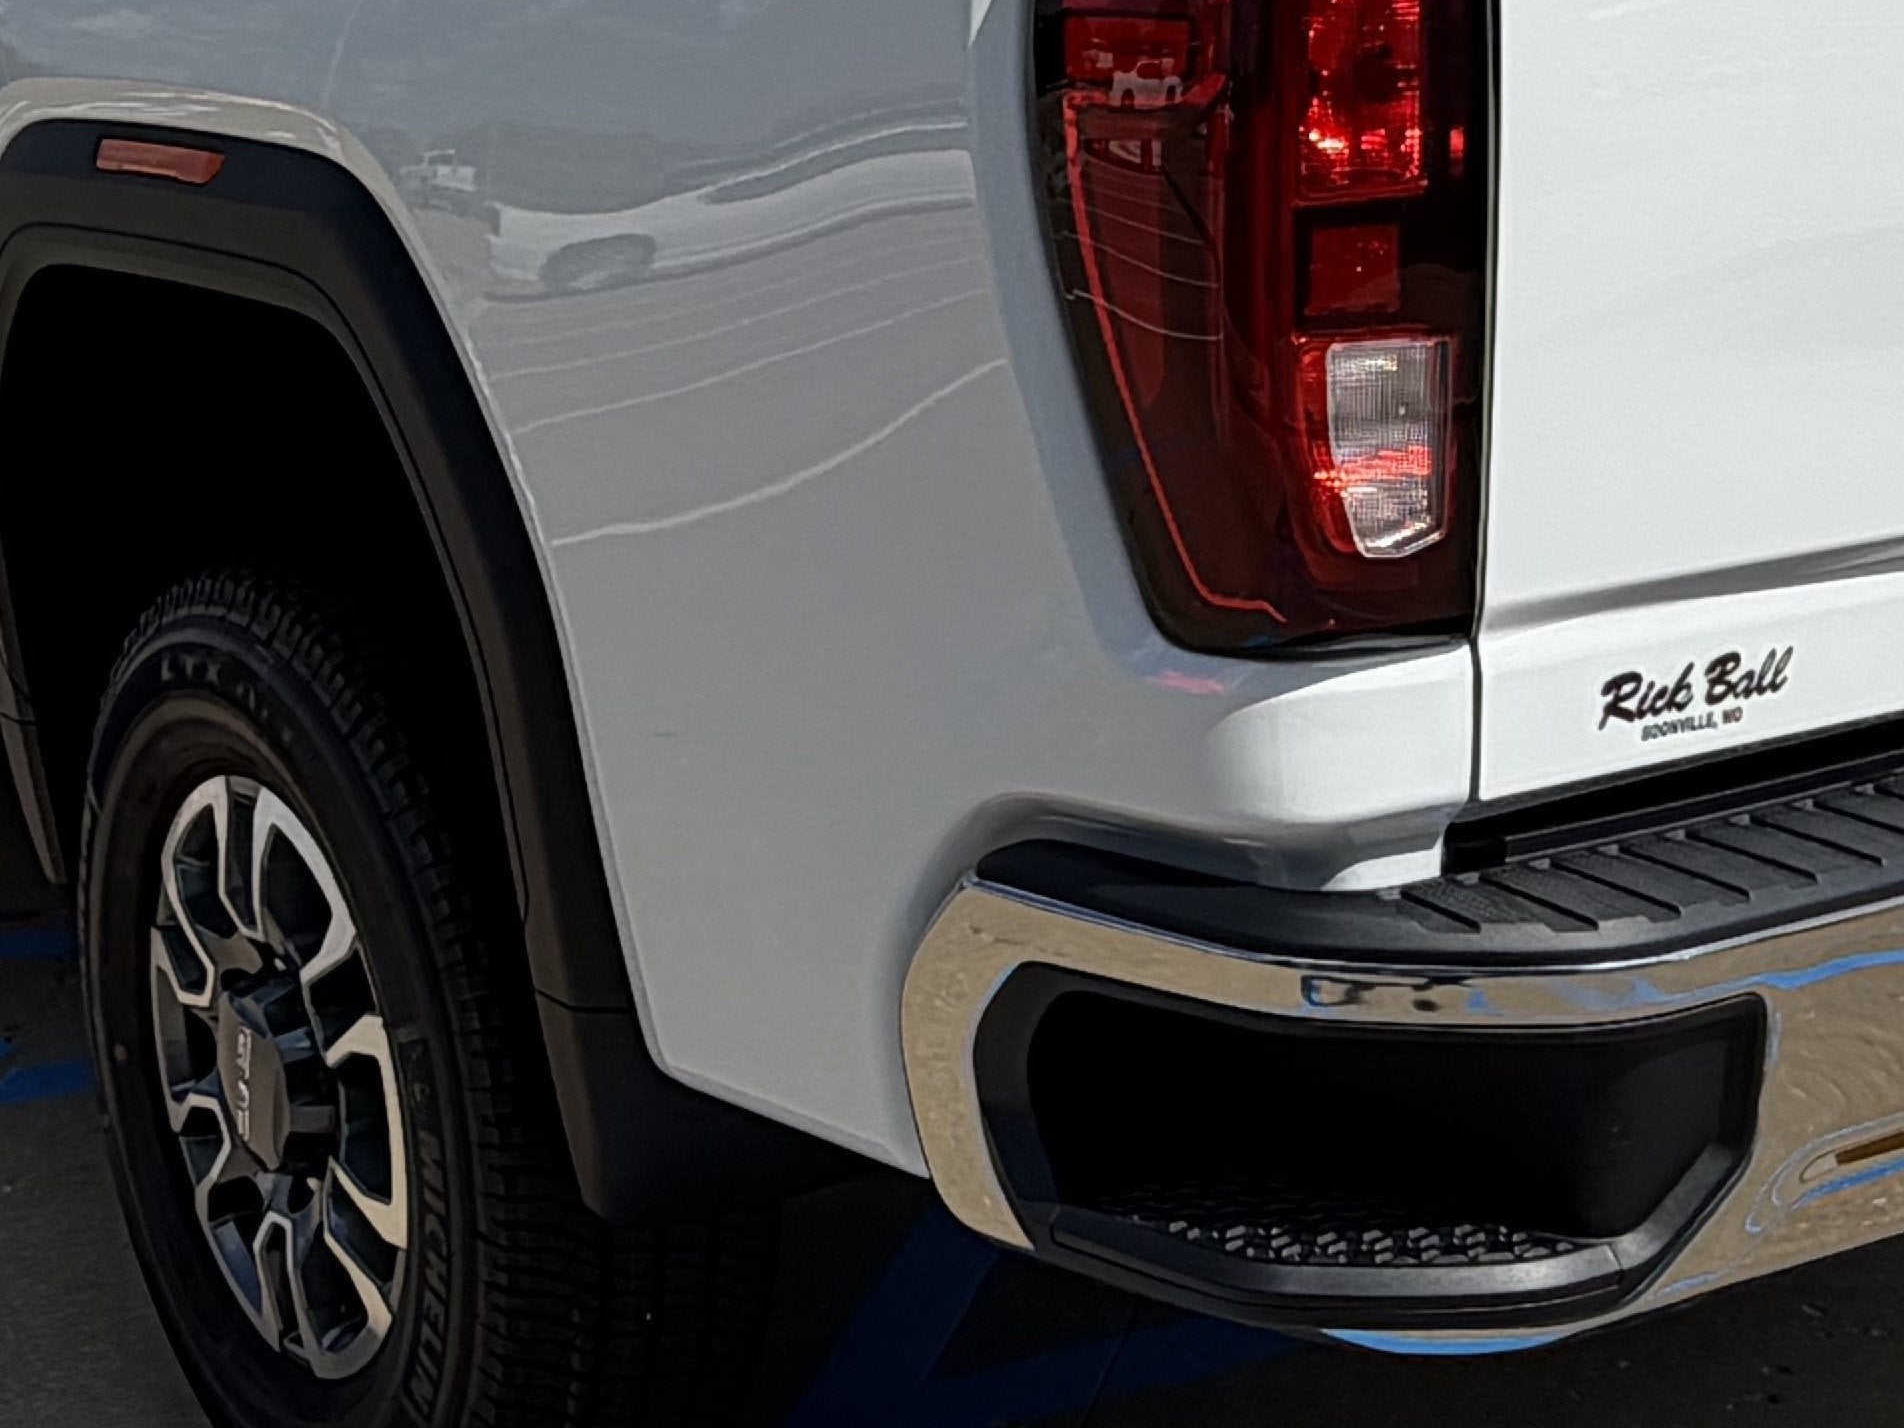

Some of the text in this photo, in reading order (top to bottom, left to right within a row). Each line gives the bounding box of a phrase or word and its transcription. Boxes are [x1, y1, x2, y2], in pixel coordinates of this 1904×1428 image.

[1597, 645, 1794, 731] Rick Ball
[410, 1129, 450, 1418] MICHELIN
